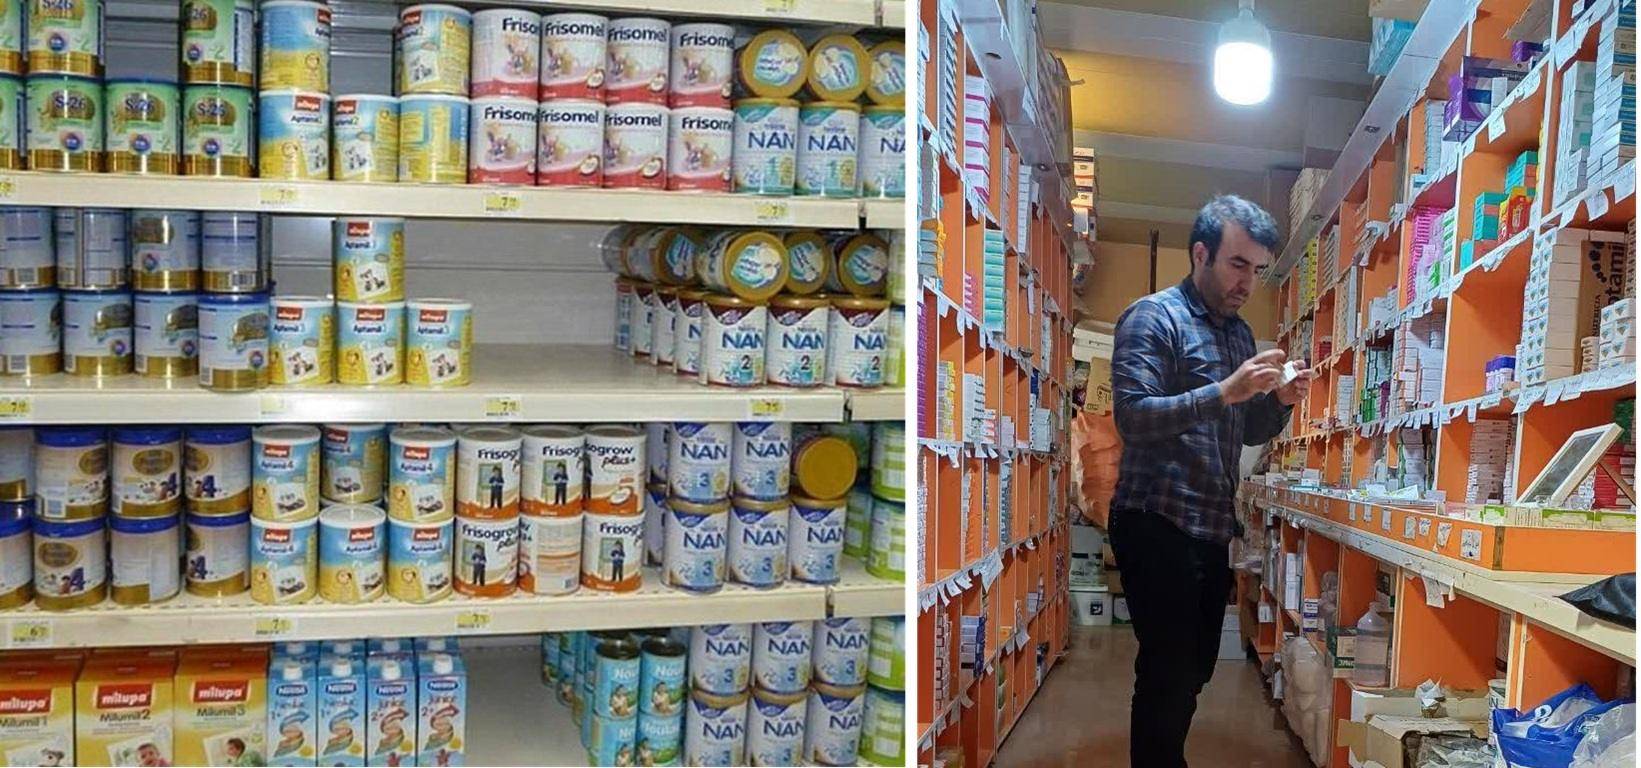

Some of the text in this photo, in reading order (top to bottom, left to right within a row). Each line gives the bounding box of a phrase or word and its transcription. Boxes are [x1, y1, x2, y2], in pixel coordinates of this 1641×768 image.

[748, 131, 795, 149] NAN
[808, 134, 856, 151] NAN
[741, 354, 753, 370] 2
[801, 354, 812, 370] 2
[871, 355, 881, 370] 2
[681, 442, 727, 459] NAN
[747, 441, 790, 458] NAN
[167, 473, 178, 496] 4
[699, 472, 709, 488] 3
[765, 470, 776, 485] 3
[203, 475, 216, 498] 4
[684, 532, 726, 549] NAN
[743, 528, 785, 545] NAN
[195, 556, 208, 580] 4
[702, 561, 713, 576] 3
[761, 557, 772, 573] 3
[826, 554, 835, 570] 3
[69, 567, 86, 591] 4
[706, 639, 749, 656] NAN
[826, 632, 868, 649] NAN
[723, 668, 733, 683] 3
[787, 667, 796, 682] 3
[846, 660, 855, 675] 3
[102, 693, 149, 706] milupa
[198, 687, 243, 699] milupa
[0, 698, 46, 711] milupa
[100, 709, 151, 722] Milumil 2
